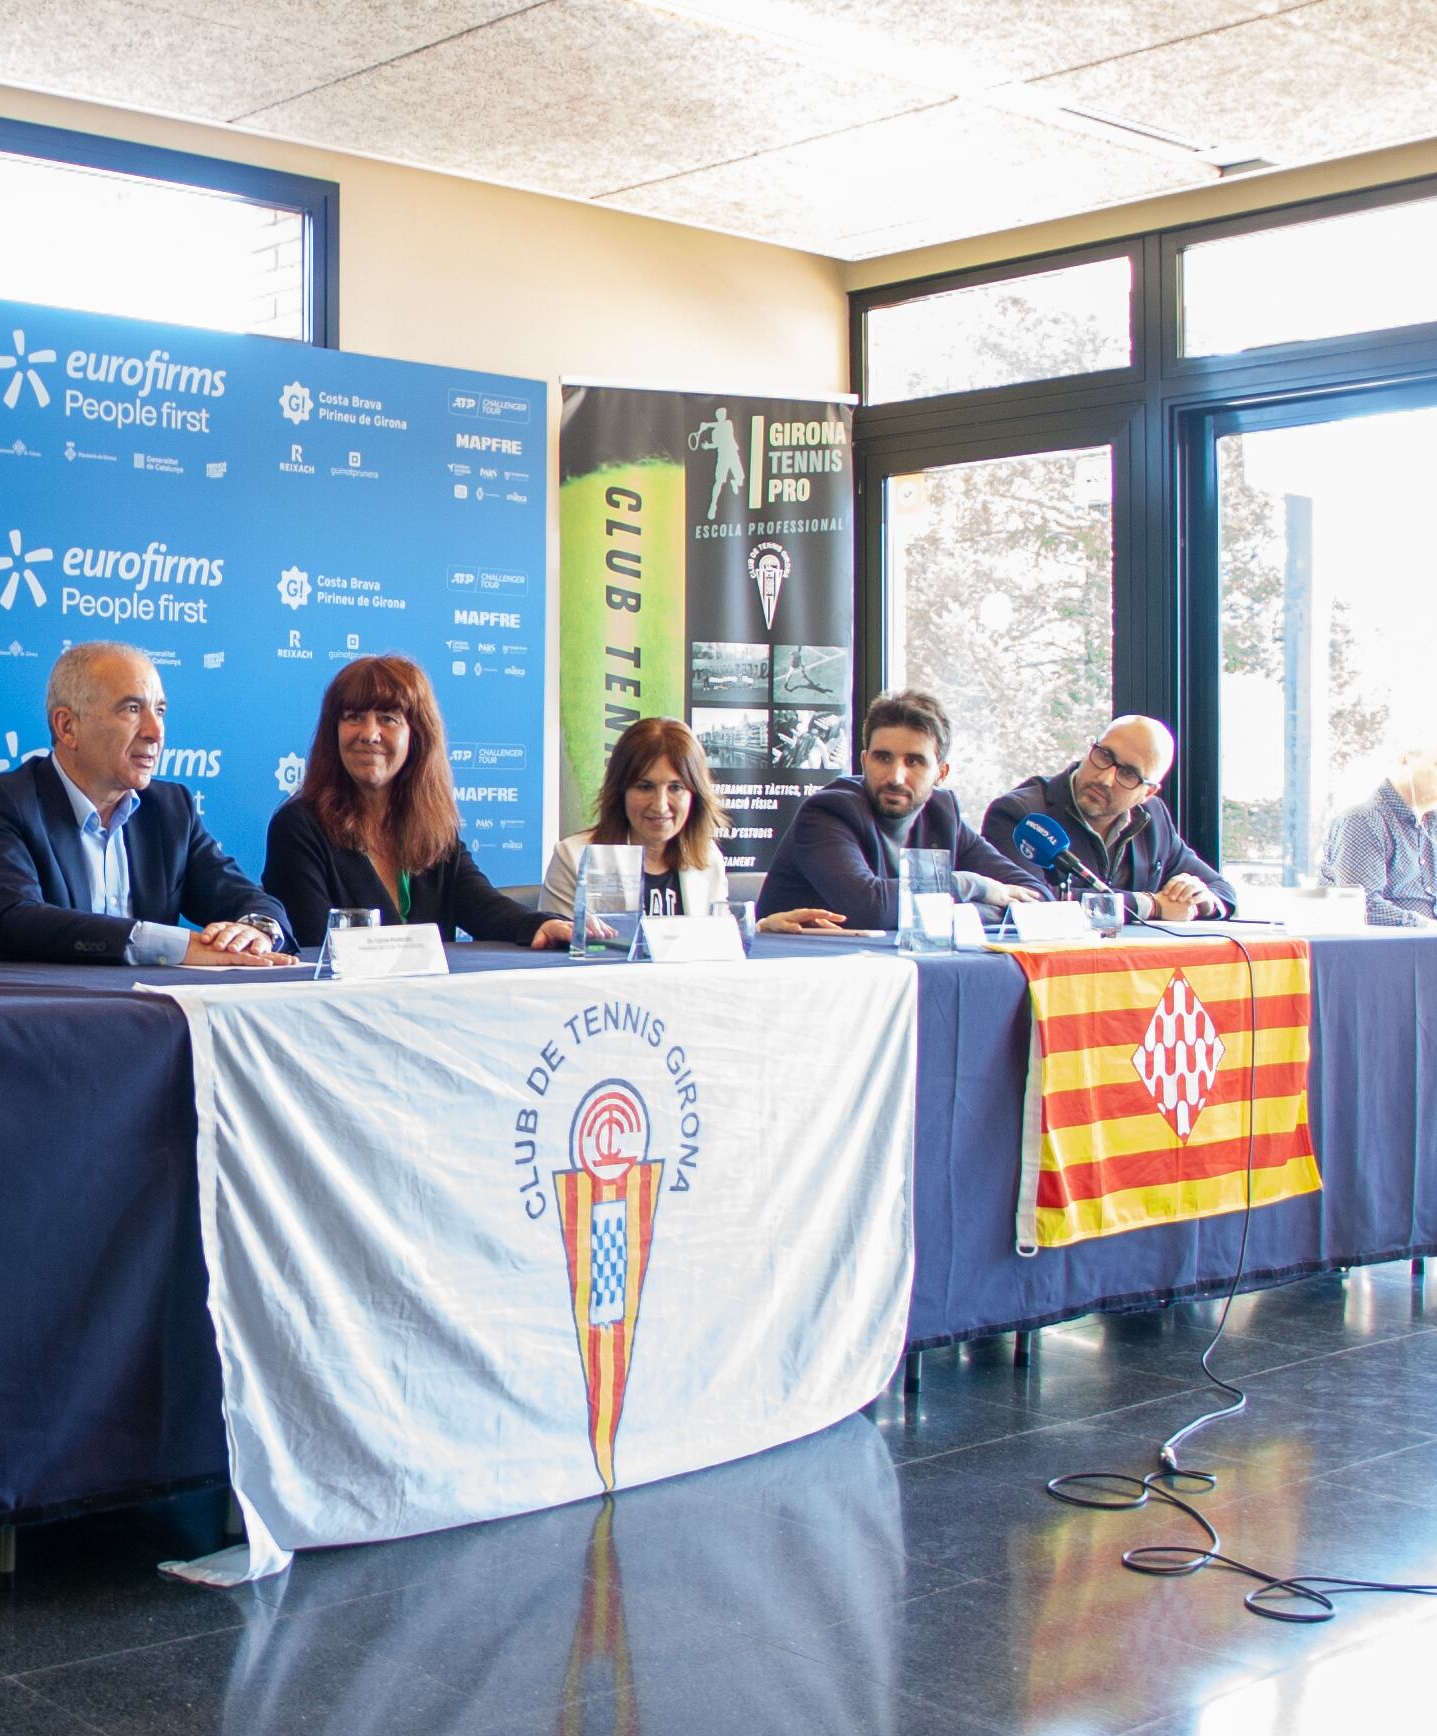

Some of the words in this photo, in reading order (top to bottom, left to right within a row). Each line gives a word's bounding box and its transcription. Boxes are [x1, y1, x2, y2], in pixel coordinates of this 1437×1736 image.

[66, 350, 226, 397] eurofirms
[66, 389, 157, 428] People
[161, 402, 210, 433] first
[319, 391, 349, 407] Costa
[352, 395, 382, 411] Brava
[452, 397, 476, 409] ATP
[482, 398, 527, 412] CHALLENGER
[319, 407, 356, 424] Pirineu
[359, 413, 371, 426] de
[374, 415, 407, 430] Girona
[456, 433, 523, 455] MAPFRE
[769, 420, 847, 447] GIRONA
[279, 462, 315, 474] REIXACH
[768, 449, 843, 474] TENNIS
[768, 478, 810, 503] PRO
[695, 520, 742, 540] ESCOLA
[748, 516, 844, 537] PROFESSIONAL
[605, 486, 642, 614] CLUB
[63, 542, 224, 591] eurofirms
[317, 575, 347, 589] Costa
[350, 577, 381, 592] Brava
[451, 572, 475, 585] ATP
[481, 573, 525, 584] CHALLENGER
[481, 580, 500, 589] TOUR
[62, 587, 154, 624] People
[158, 593, 208, 624] first
[317, 591, 355, 606] Pirineu
[357, 595, 370, 607] de
[372, 595, 406, 610] Girona
[454, 609, 521, 628] MAPFRE
[277, 648, 313, 659] REIXACH
[450, 750, 472, 761] ATP
[479, 748, 523, 757] CHALLENGER
[452, 786, 518, 802] MAPFRE
[751, 797, 778, 809] FÍSICA
[563, 1001, 665, 1047] TENNIS
[526, 1040, 565, 1096] DE
[666, 1045, 700, 1192] GIRONA
[515, 1108, 547, 1220] CLUB
